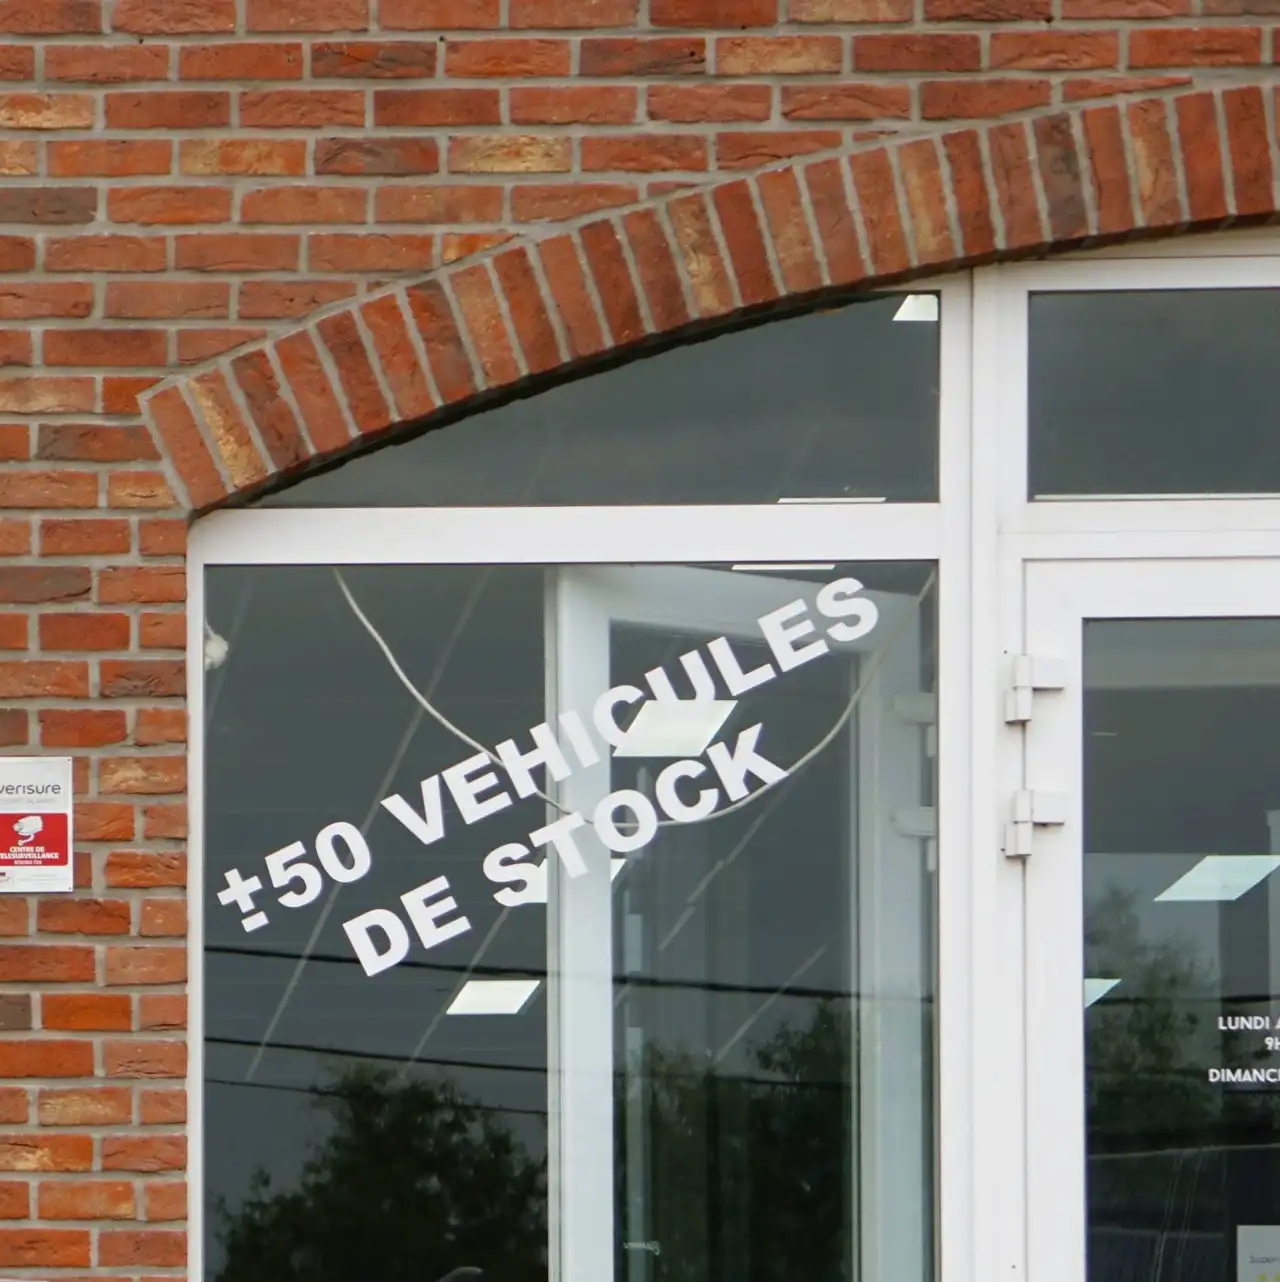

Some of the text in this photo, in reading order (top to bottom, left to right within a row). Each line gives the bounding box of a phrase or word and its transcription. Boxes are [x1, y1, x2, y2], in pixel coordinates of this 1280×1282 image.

[381, 577, 879, 845] VEHICULES
[343, 723, 789, 977] DE STOCK
[1208, 1068, 1280, 1082] DIMANC
[1218, 1016, 1270, 1030] LUNDI
